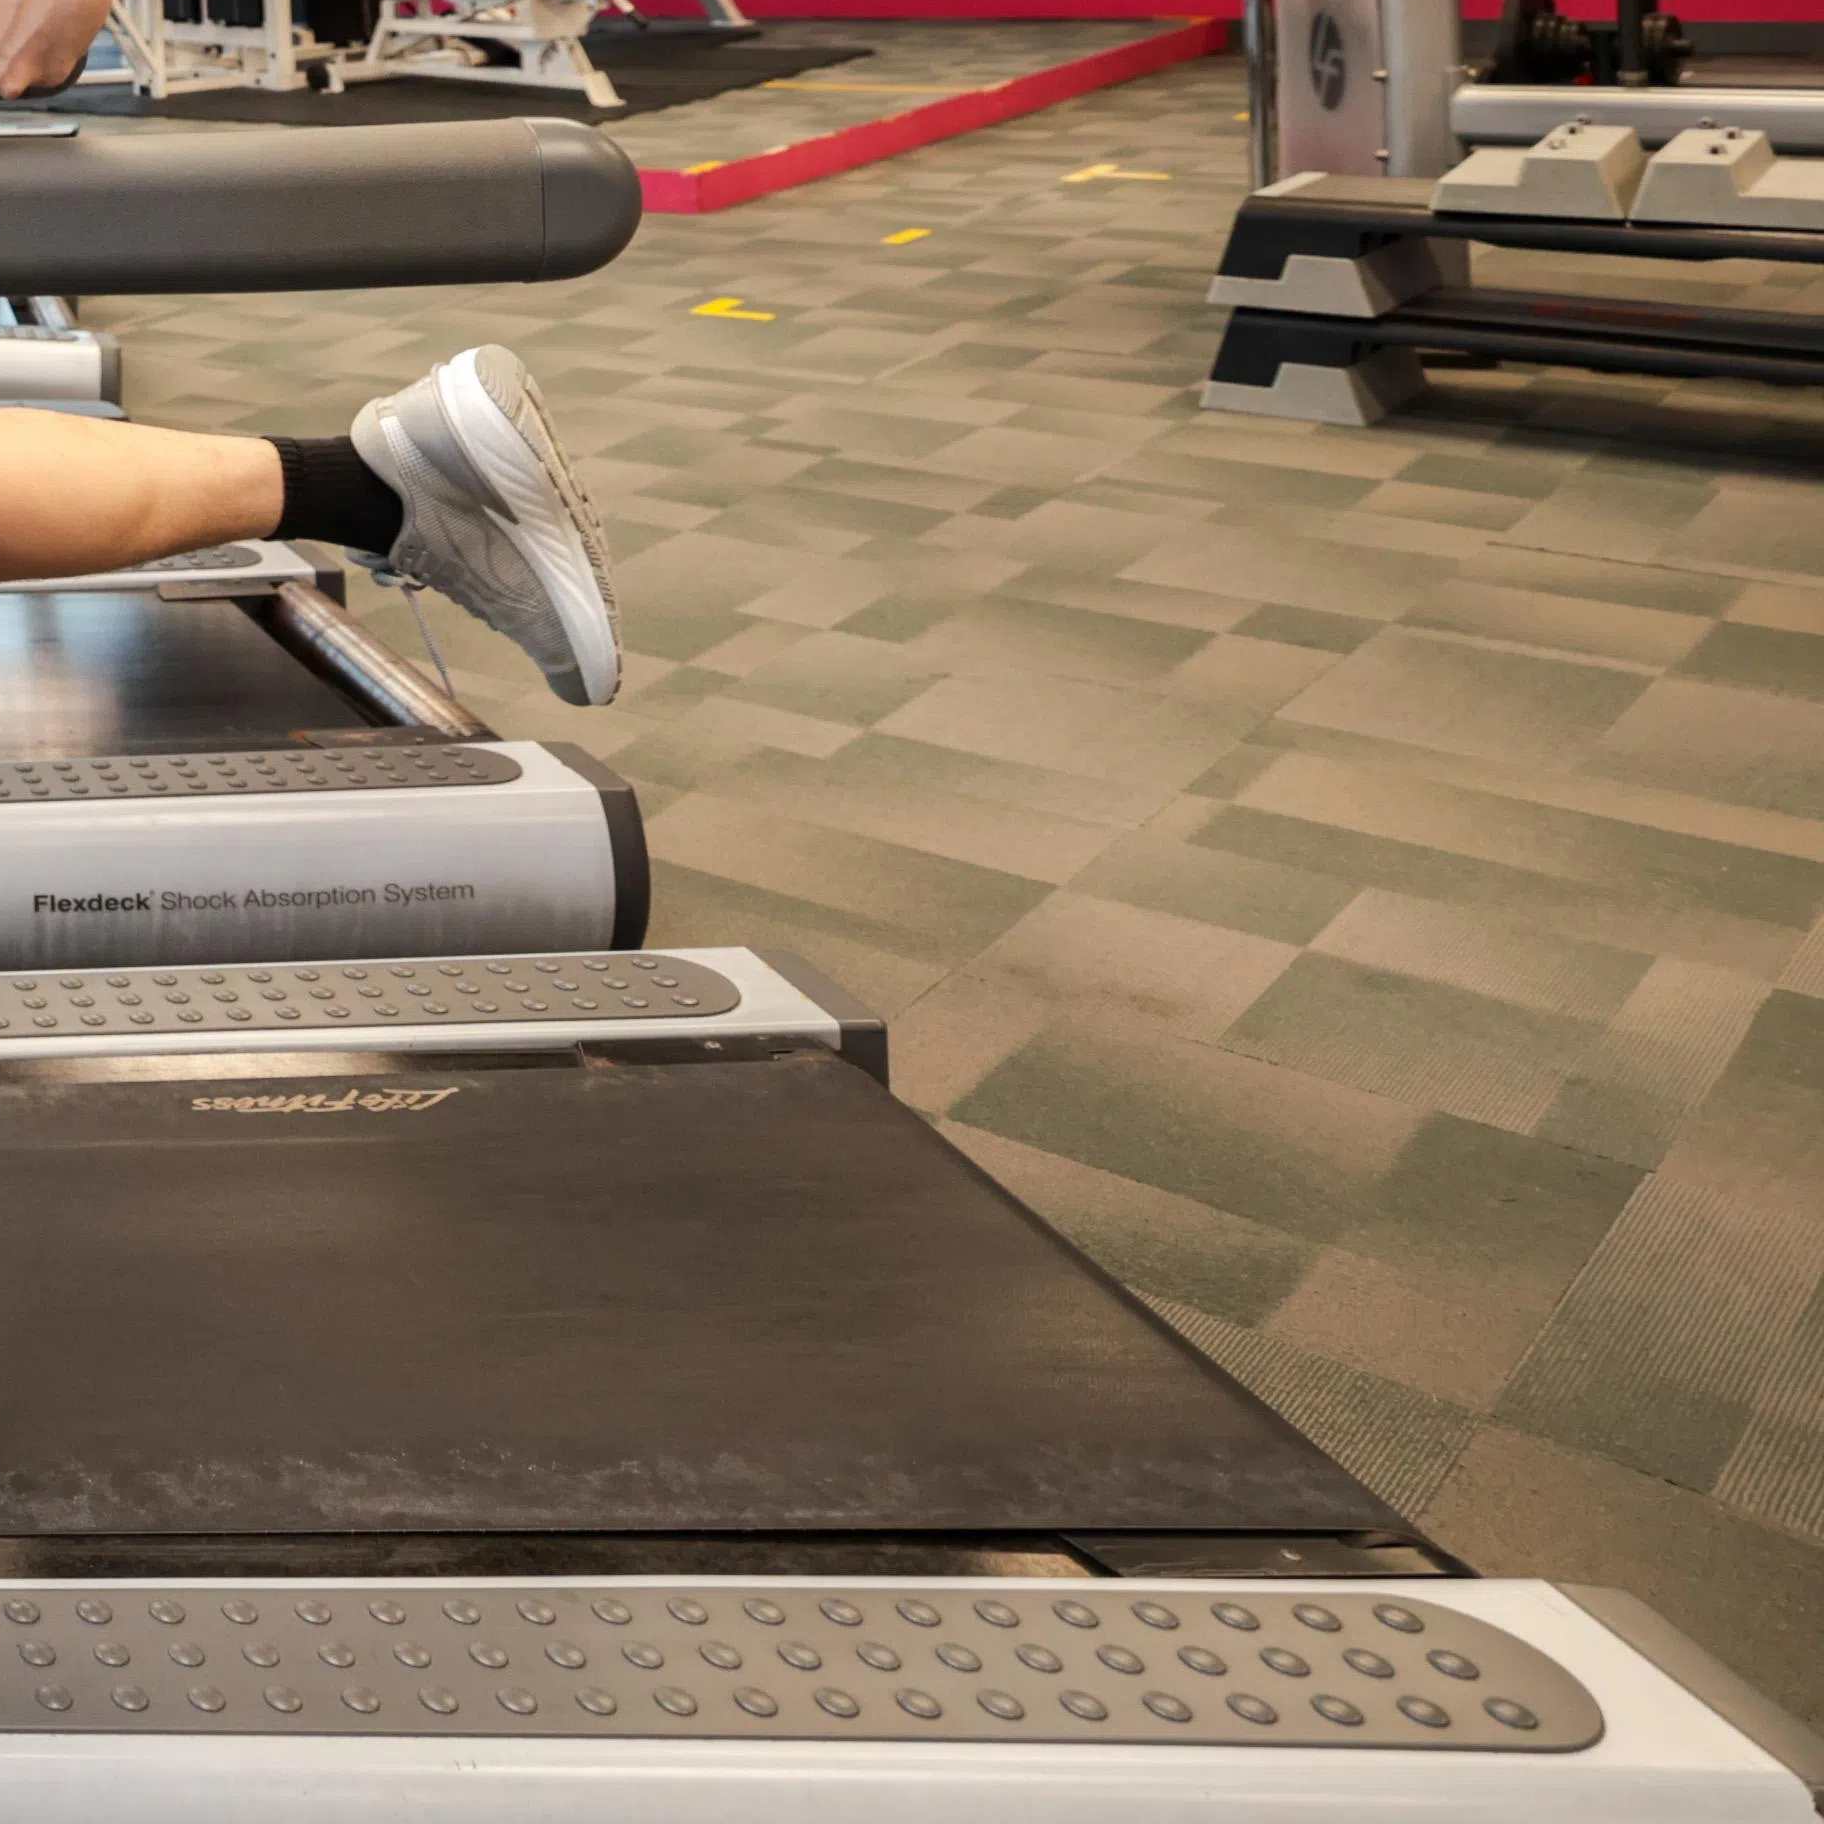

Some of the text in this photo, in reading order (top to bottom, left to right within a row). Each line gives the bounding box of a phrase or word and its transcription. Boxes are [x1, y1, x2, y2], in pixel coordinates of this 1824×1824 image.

[32, 882, 475, 913] Flexdeck Shock Absorption System
